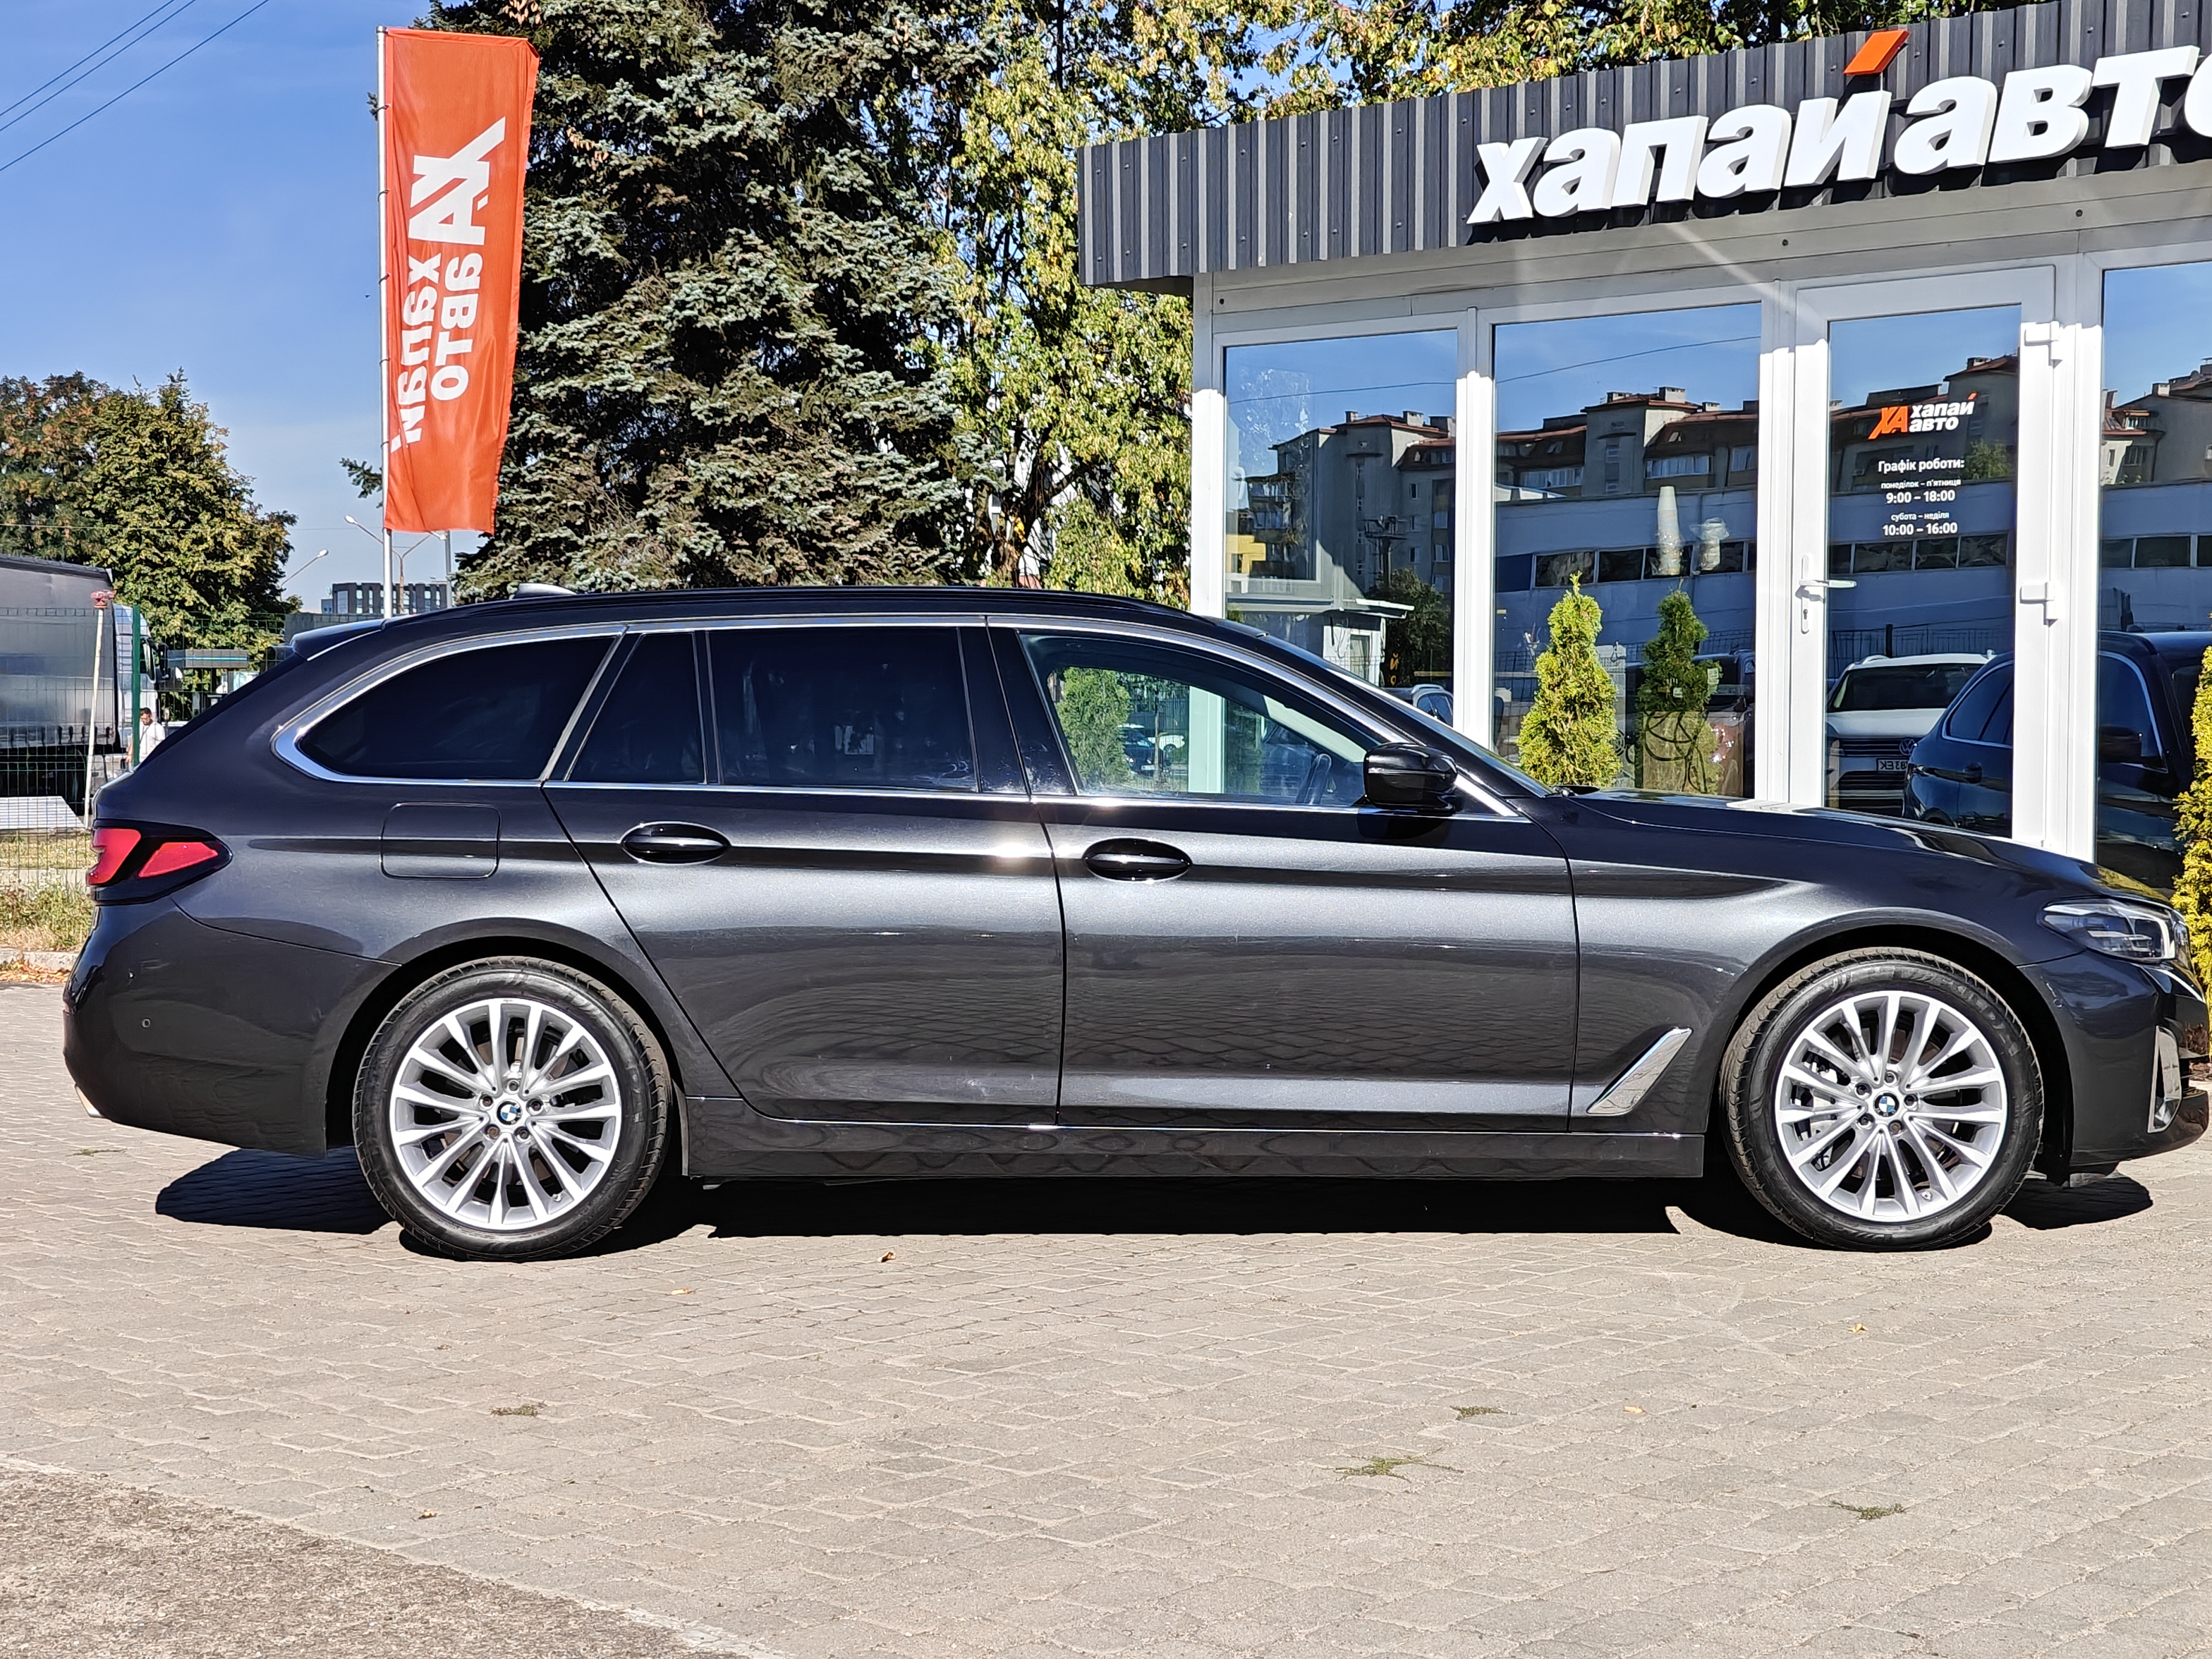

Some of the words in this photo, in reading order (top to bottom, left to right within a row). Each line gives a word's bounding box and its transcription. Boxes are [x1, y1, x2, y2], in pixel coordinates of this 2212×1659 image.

[1910, 392, 1977, 418] хапай
[1909, 416, 1959, 433] авто
[1878, 459, 1916, 475] Графік
[1919, 457, 1964, 473] роботи:
[1880, 480, 1919, 490] понеділок
[1885, 492, 1912, 504] 9:00
[1923, 490, 1956, 503] 18:00
[1890, 512, 1916, 522] субота
[1924, 511, 1950, 521] неділя
[1882, 523, 1914, 536] 10:00
[1926, 522, 1958, 535] 16:00
